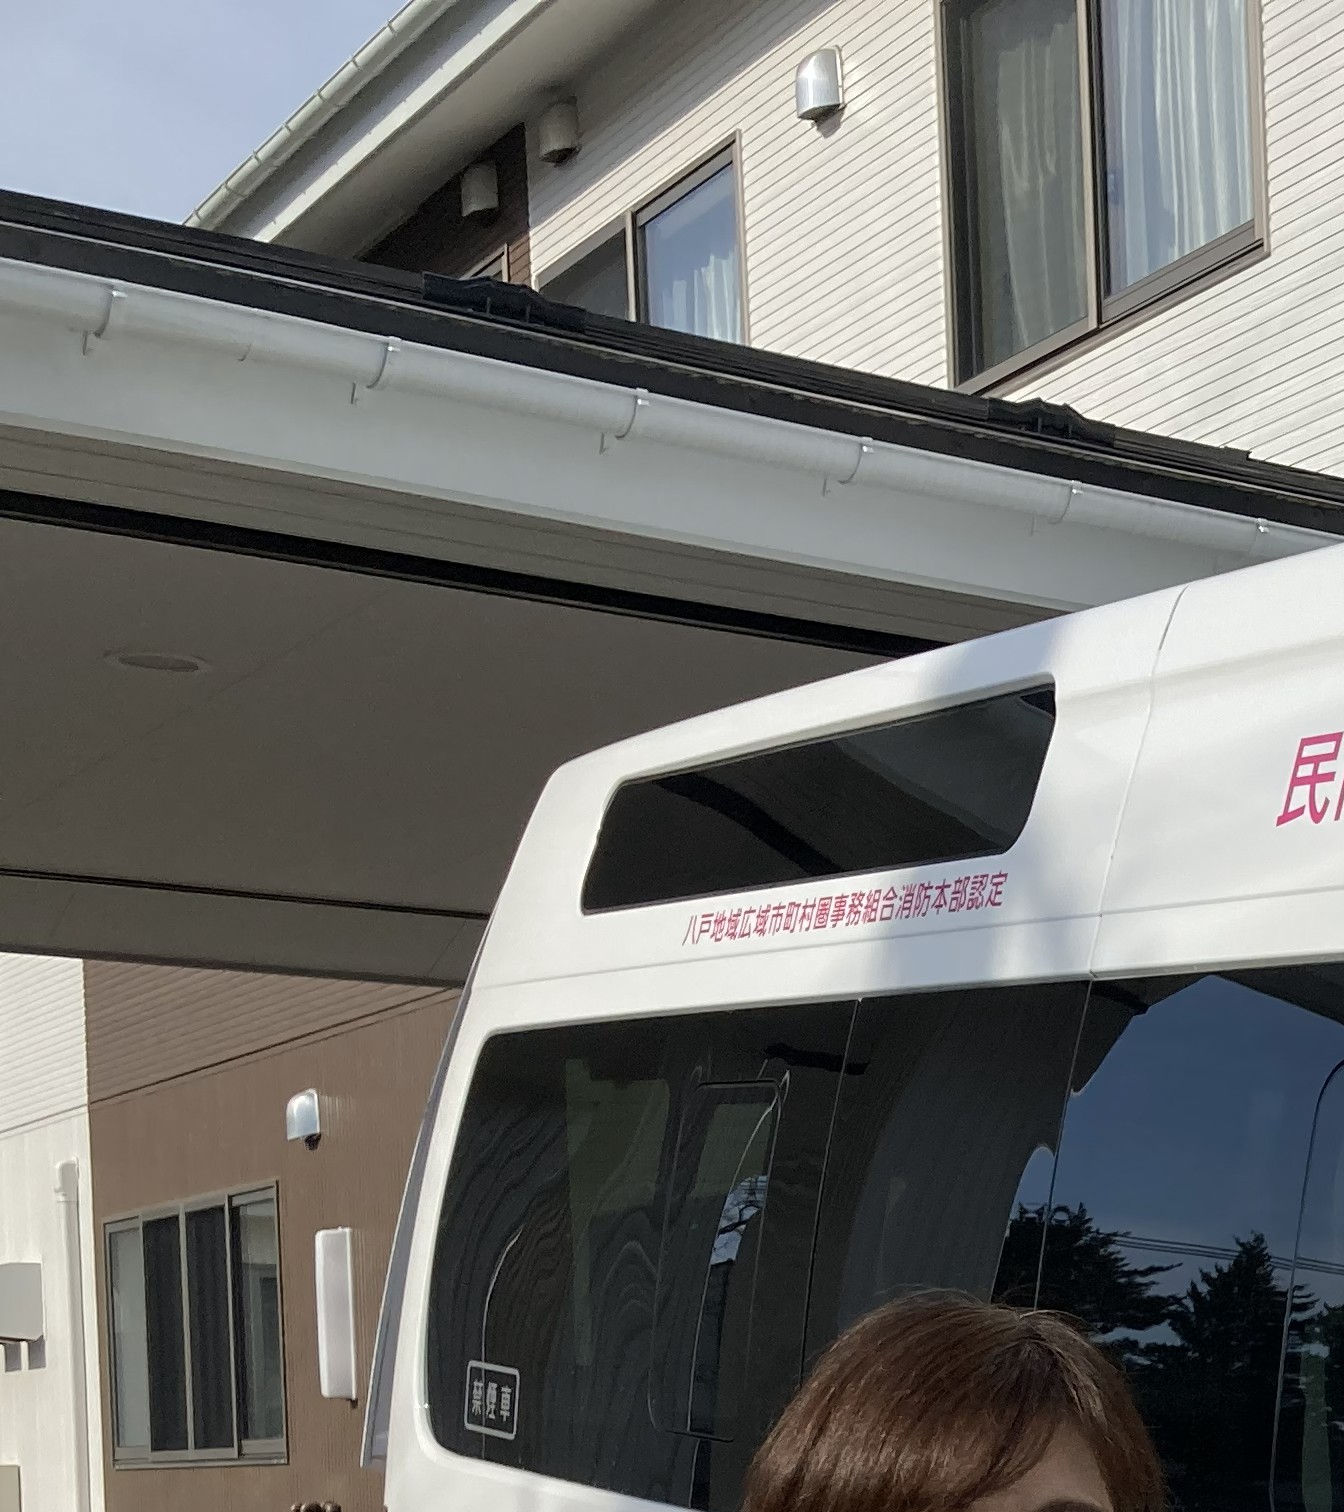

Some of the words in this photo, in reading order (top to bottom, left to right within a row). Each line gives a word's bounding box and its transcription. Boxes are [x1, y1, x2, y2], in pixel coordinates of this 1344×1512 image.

[682, 870, 1008, 946] 八戸地域広域市町村圏事務組合消防本部認定
